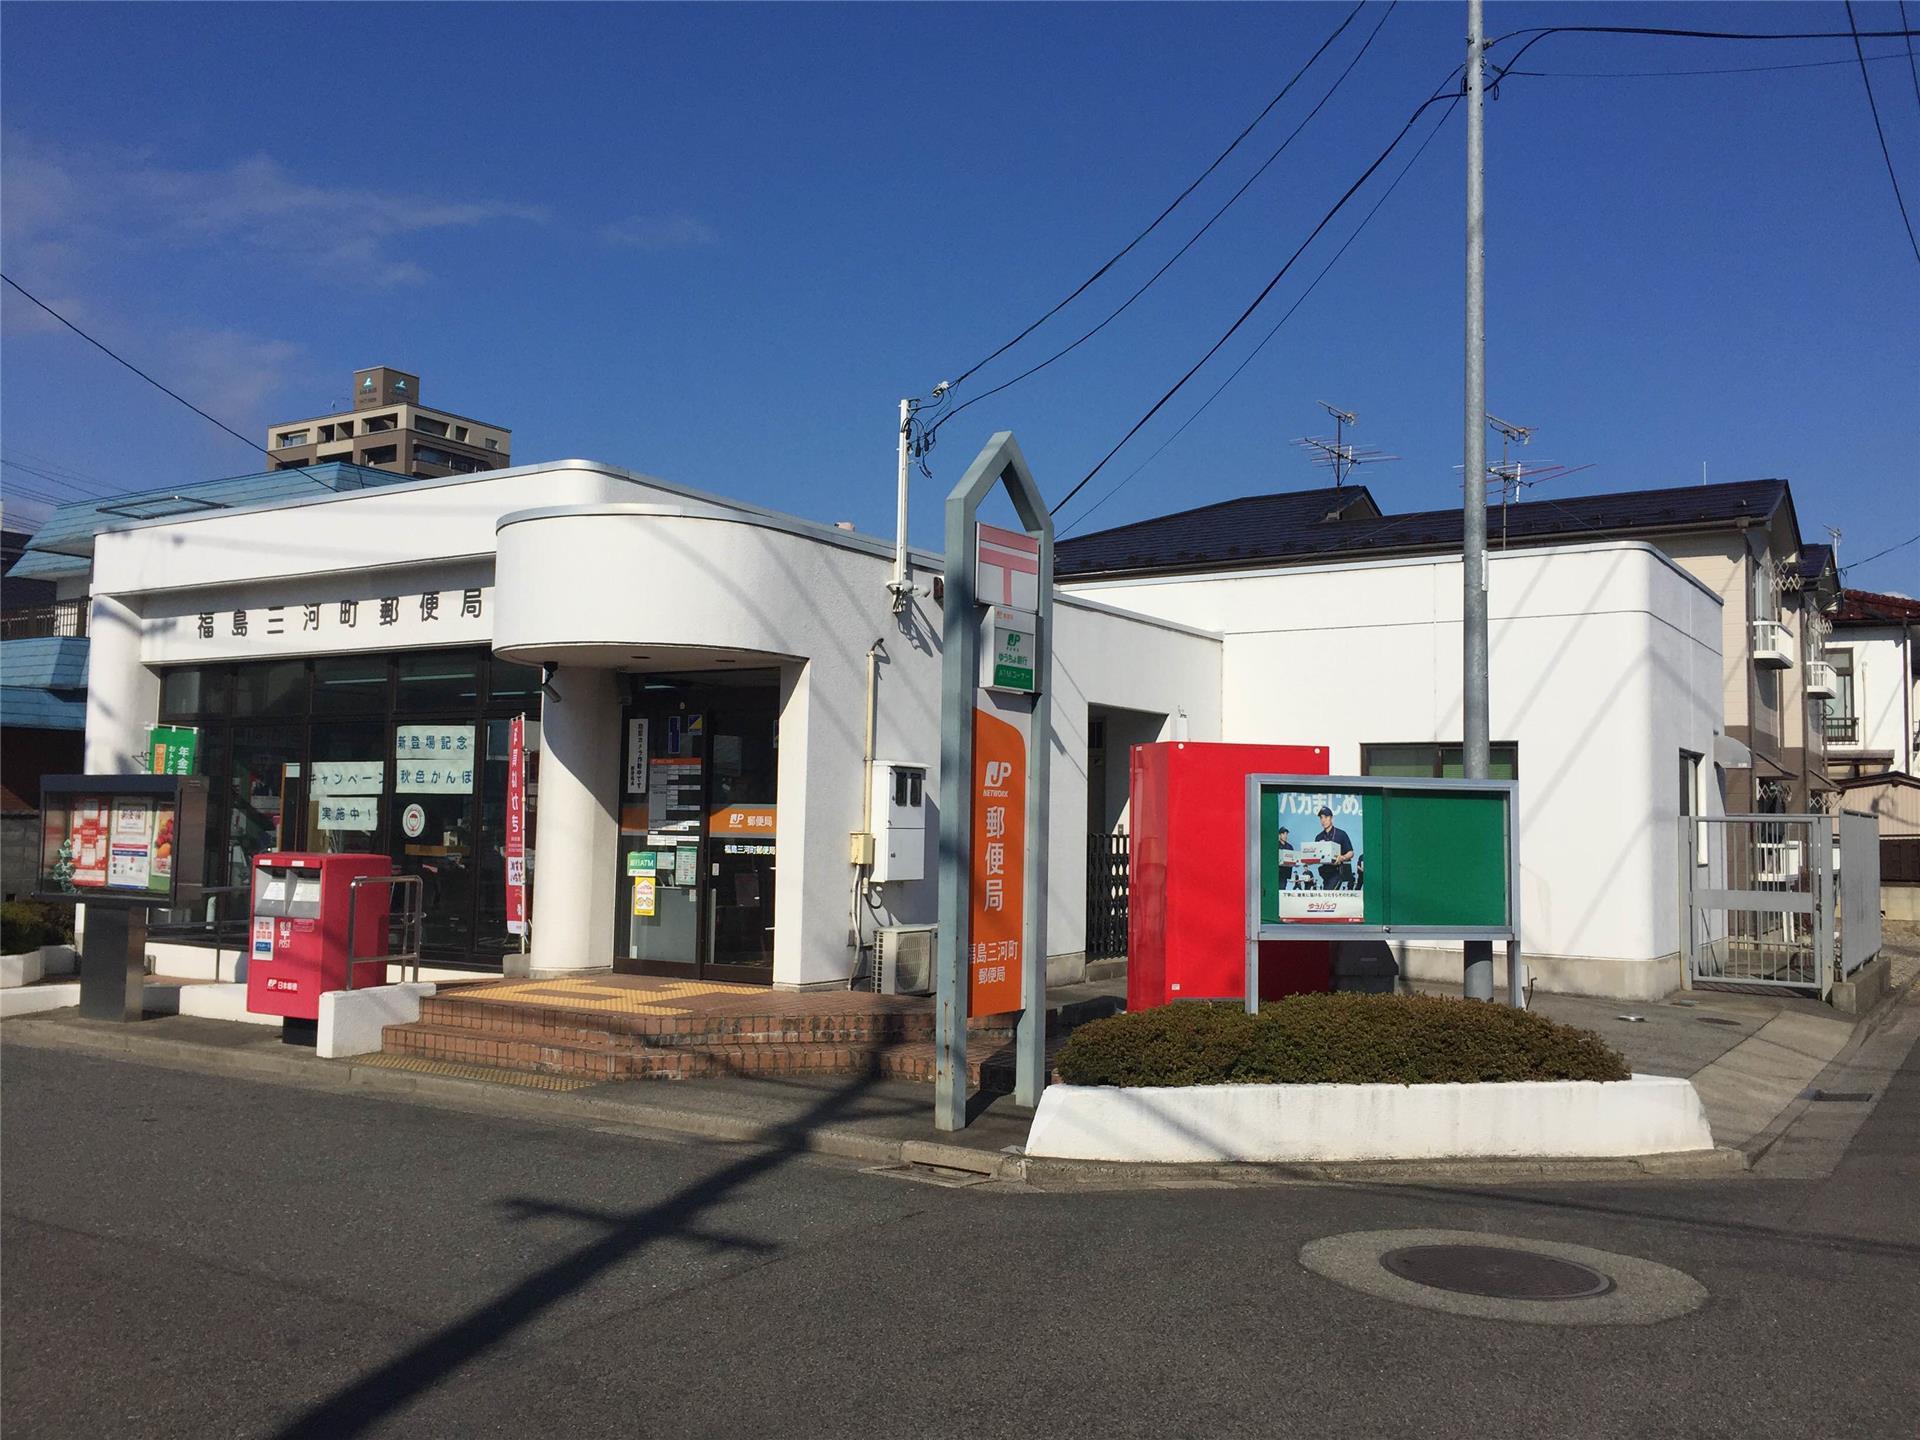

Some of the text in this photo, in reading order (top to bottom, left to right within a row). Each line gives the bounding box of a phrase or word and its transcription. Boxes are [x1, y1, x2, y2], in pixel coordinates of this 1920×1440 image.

[197, 588, 482, 639] 福島三河町郵便局
[398, 736, 467, 750] 新登場記念
[400, 770, 472, 785] 秋色かんぽ
[984, 761, 1011, 787] JP
[983, 789, 1009, 798] NETWORK
[1280, 793, 1363, 816] バカまじめ。
[747, 816, 773, 827] 郵便局
[984, 806, 1005, 912] 郵便局
[279, 939, 291, 948] POST
[978, 966, 1006, 984] 郵便局
